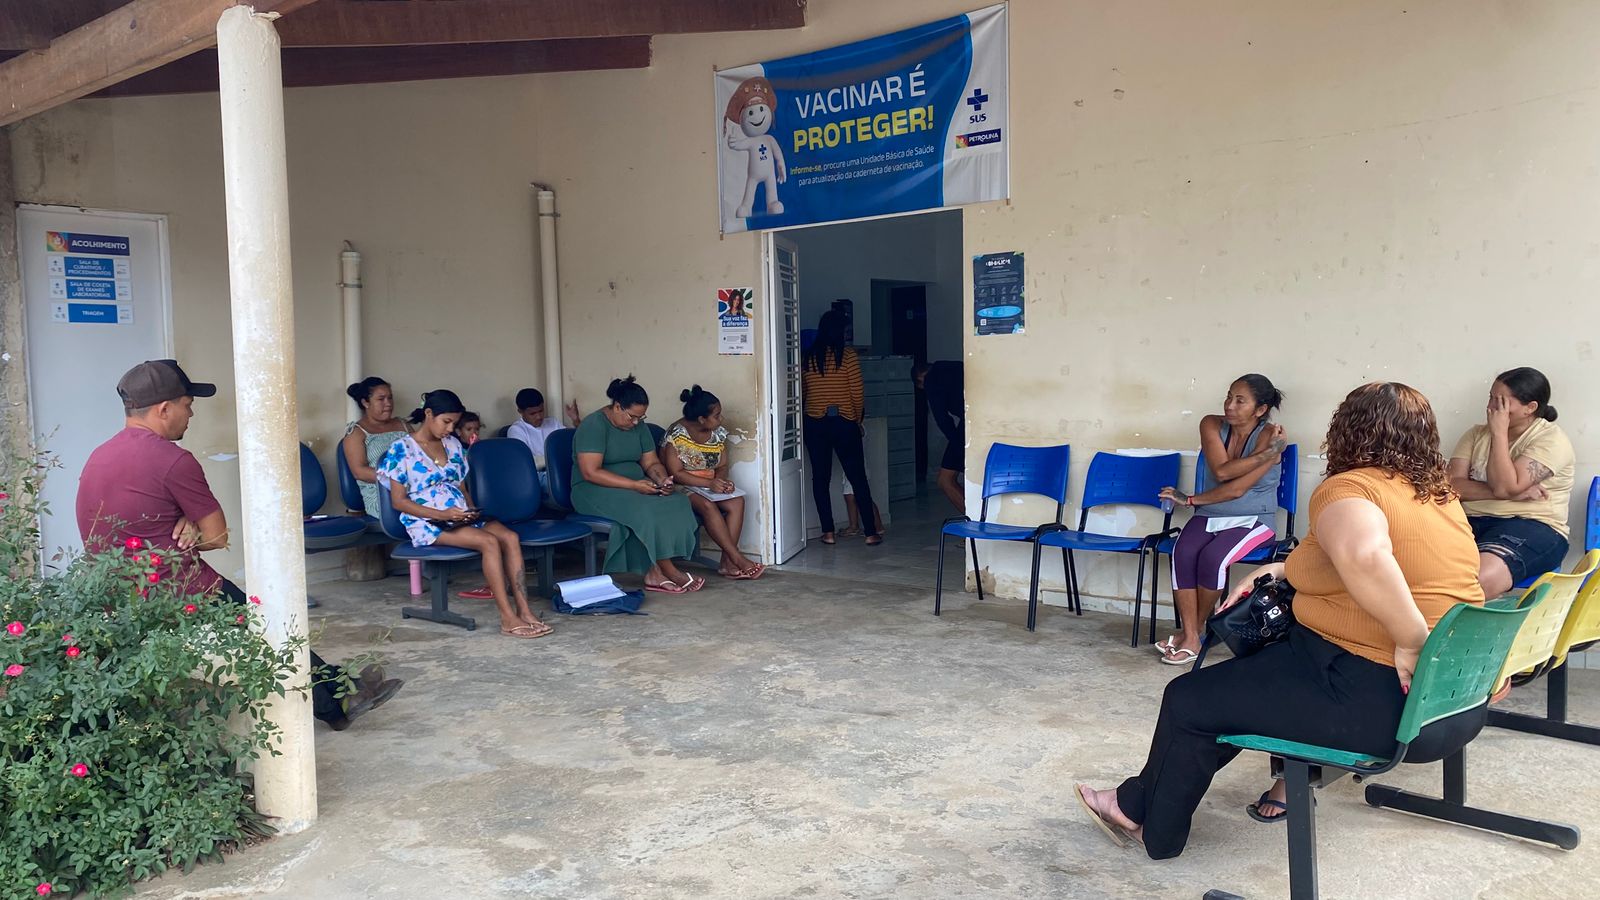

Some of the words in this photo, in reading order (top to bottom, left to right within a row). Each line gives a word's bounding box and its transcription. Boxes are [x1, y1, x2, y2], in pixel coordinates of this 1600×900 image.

[795, 76, 904, 118] VACINAR
[909, 64, 926, 97] É
[793, 105, 934, 153] PROTEGER!
[970, 113, 986, 124] SUS
[968, 132, 998, 142] PETROLINA
[823, 160, 846, 171] procure
[860, 153, 885, 165] Unidade
[886, 150, 905, 161] Básica
[906, 148, 914, 157] de
[914, 144, 935, 156] Saúde
[799, 177, 811, 187] para
[811, 171, 844, 184] atualização
[845, 170, 853, 179] da
[853, 166, 883, 178] caderneta
[884, 164, 892, 173] de
[892, 160, 924, 172] vacinação.
[72, 240, 127, 250] ACOLHIMENTO
